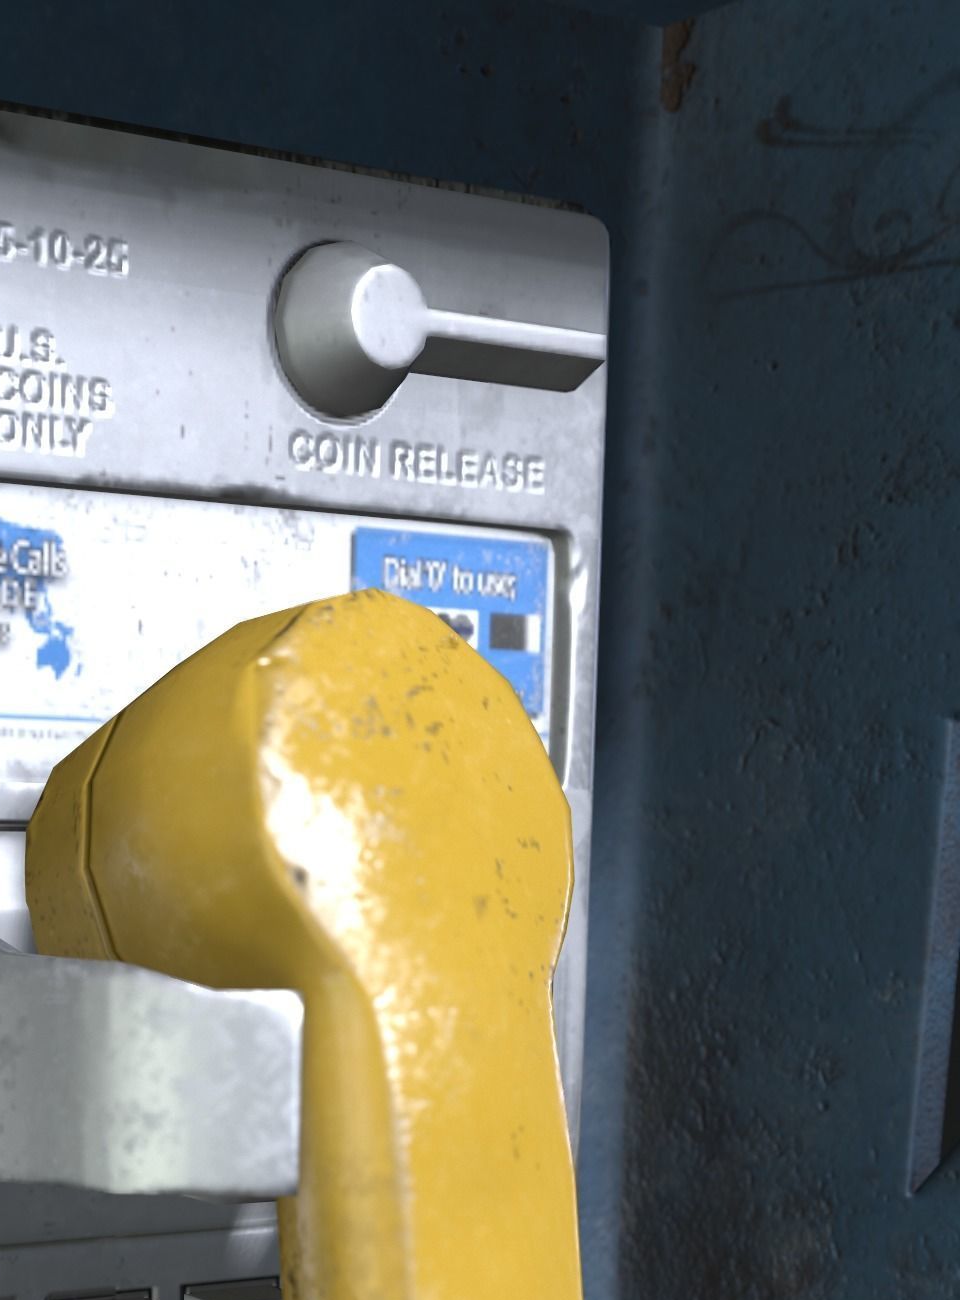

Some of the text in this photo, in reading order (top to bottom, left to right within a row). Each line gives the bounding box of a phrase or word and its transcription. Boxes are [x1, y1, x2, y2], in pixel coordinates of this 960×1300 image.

[289, 428, 545, 496] COIN RELEASE
[10, 538, 68, 579] Calls
[382, 555, 423, 592] Dial
[452, 562, 474, 595] to
